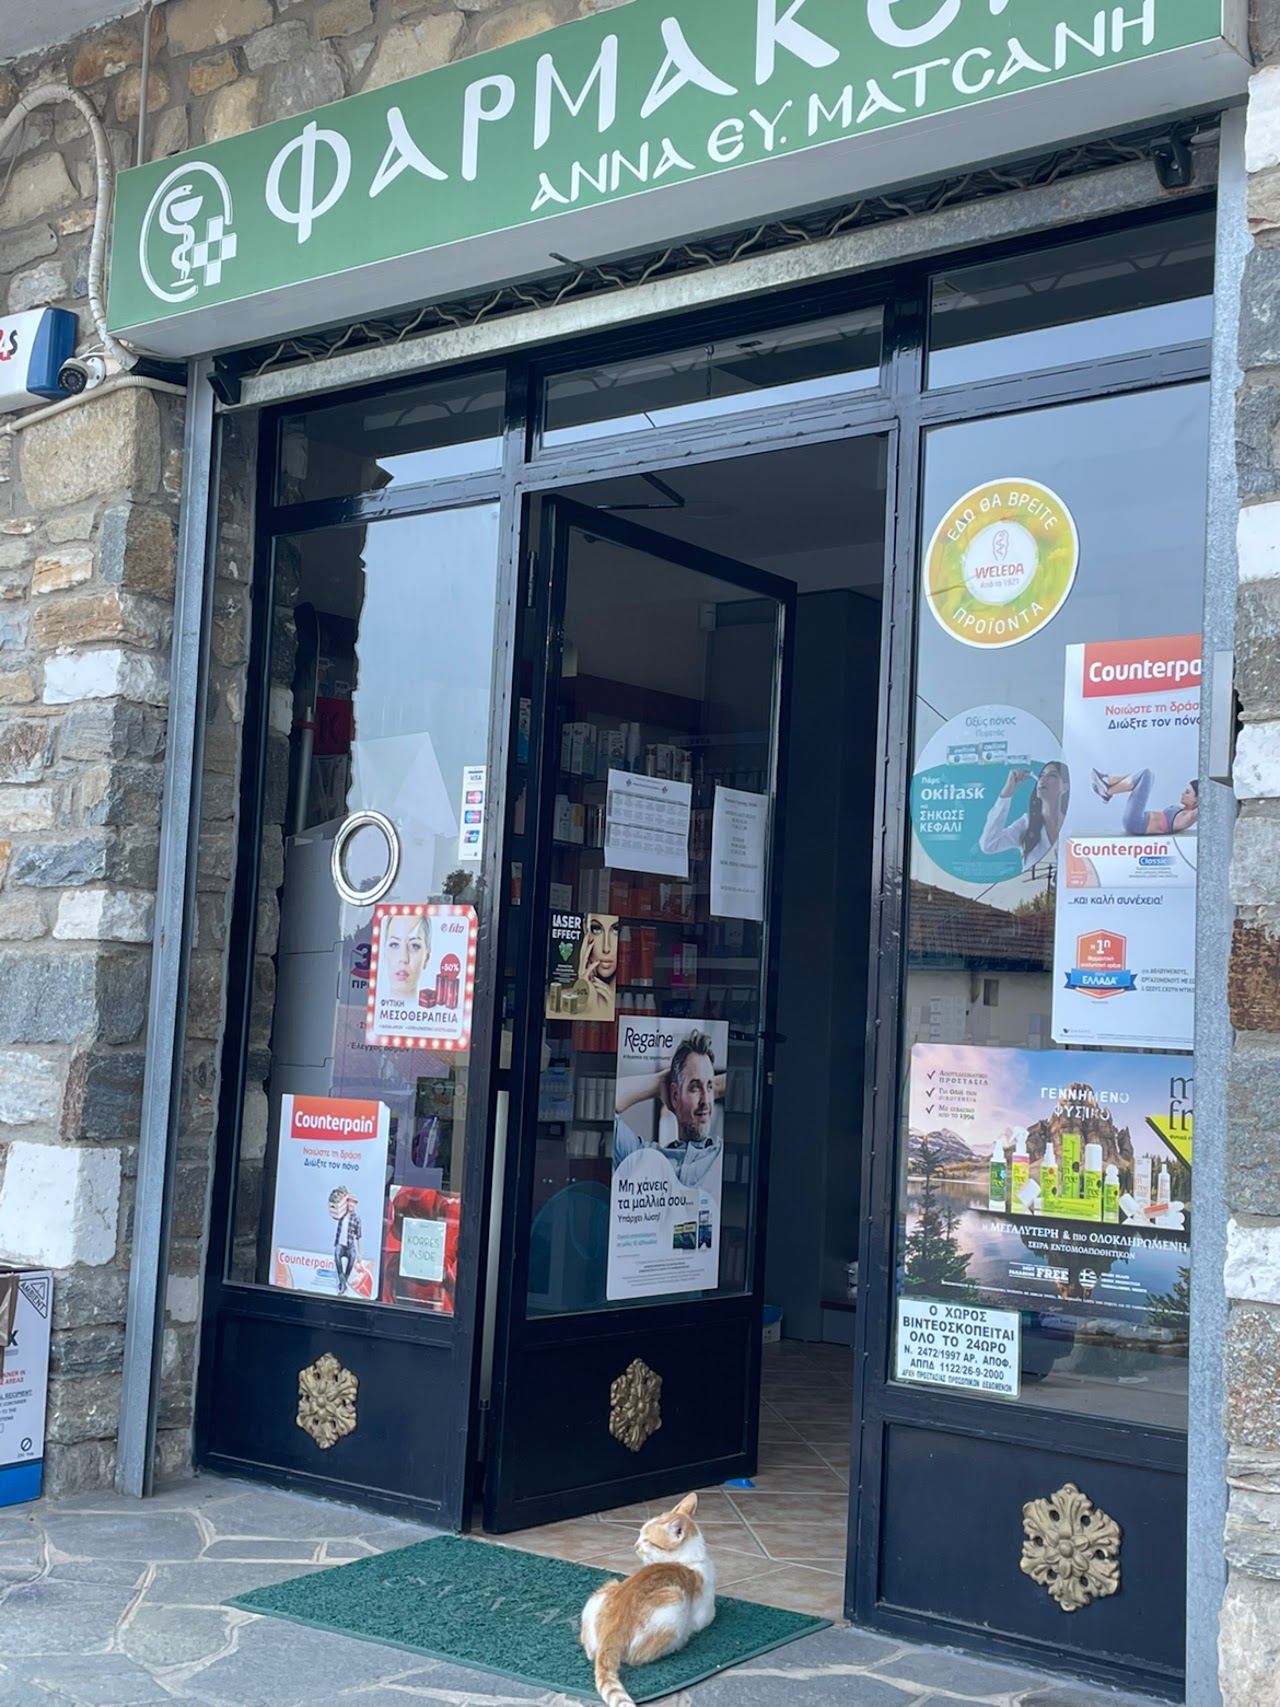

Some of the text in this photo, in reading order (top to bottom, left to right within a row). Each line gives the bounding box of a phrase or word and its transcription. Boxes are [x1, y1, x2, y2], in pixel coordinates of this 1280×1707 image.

[531, 136, 696, 212] ΑΝΝΑ
[947, 491, 1058, 542] ΕΔΩ ΘΑ ΒΡΕΙΤΕ
[975, 563, 1024, 579] WELEDA
[952, 601, 1044, 635] ΠΡΟΪΟΝΤΑ
[1105, 704, 1151, 716] Νοιώστε
[1155, 703, 1167, 713] τη
[989, 715, 1017, 726] πόνος
[1107, 717, 1148, 730] Διώξτε
[1151, 717, 1171, 727] τον
[920, 809, 965, 821] ΣΗΚΩΣΕ
[920, 821, 962, 833] ΚΕΦΑΛΙ
[1090, 894, 1115, 905] καλή
[1116, 893, 1164, 906] συνέχεια!
[552, 914, 581, 929] LASER
[552, 928, 581, 940] EFFECT
[380, 999, 405, 1008] ΦΥΤΙΚΗ
[380, 1010, 458, 1023] ΜΕΣΟΘΕΡΑΠΕΙΑ
[624, 1027, 673, 1053] Regaine
[295, 1111, 373, 1135] Counterpain
[304, 1158, 360, 1171] Διώξτε τον πόνο
[618, 1177, 668, 1195] Μη χάνεις
[618, 1199, 630, 1210] τα
[632, 1193, 666, 1211] μαλλιά
[617, 1213, 643, 1224] Υπάρχει
[407, 1235, 440, 1249] KORRES
[990, 1223, 1060, 1239] ΜΕΓΑΛΥΤΕΡΗ
[1062, 1230, 1071, 1240] &
[1089, 1232, 1188, 1253] ΟΛΟΚΛΗΡΩΜΕΝΗ
[279, 1252, 335, 1269] Counterpain
[408, 1249, 437, 1262] INSIDE
[1036, 1267, 1070, 1281] FREE
[20, 1281, 47, 1311] AMBIENT
[929, 1305, 987, 1323] Ο ΧΩΡΟΣ
[903, 1316, 1015, 1342] ΒΙΝΤΕΟΣΚΟΠΕΙΤΑΙ
[910, 1331, 1007, 1354] ΟΛΟ ΤΟ 24ΩΡΟ
[917, 1346, 961, 1361] 2472/1997
[963, 1353, 978, 1364] ΑΡ.
[982, 1355, 1012, 1369] ΑΠΟΦ.
[910, 1358, 1005, 1381] ΑΠΠΔ 1122/26-9-2000
